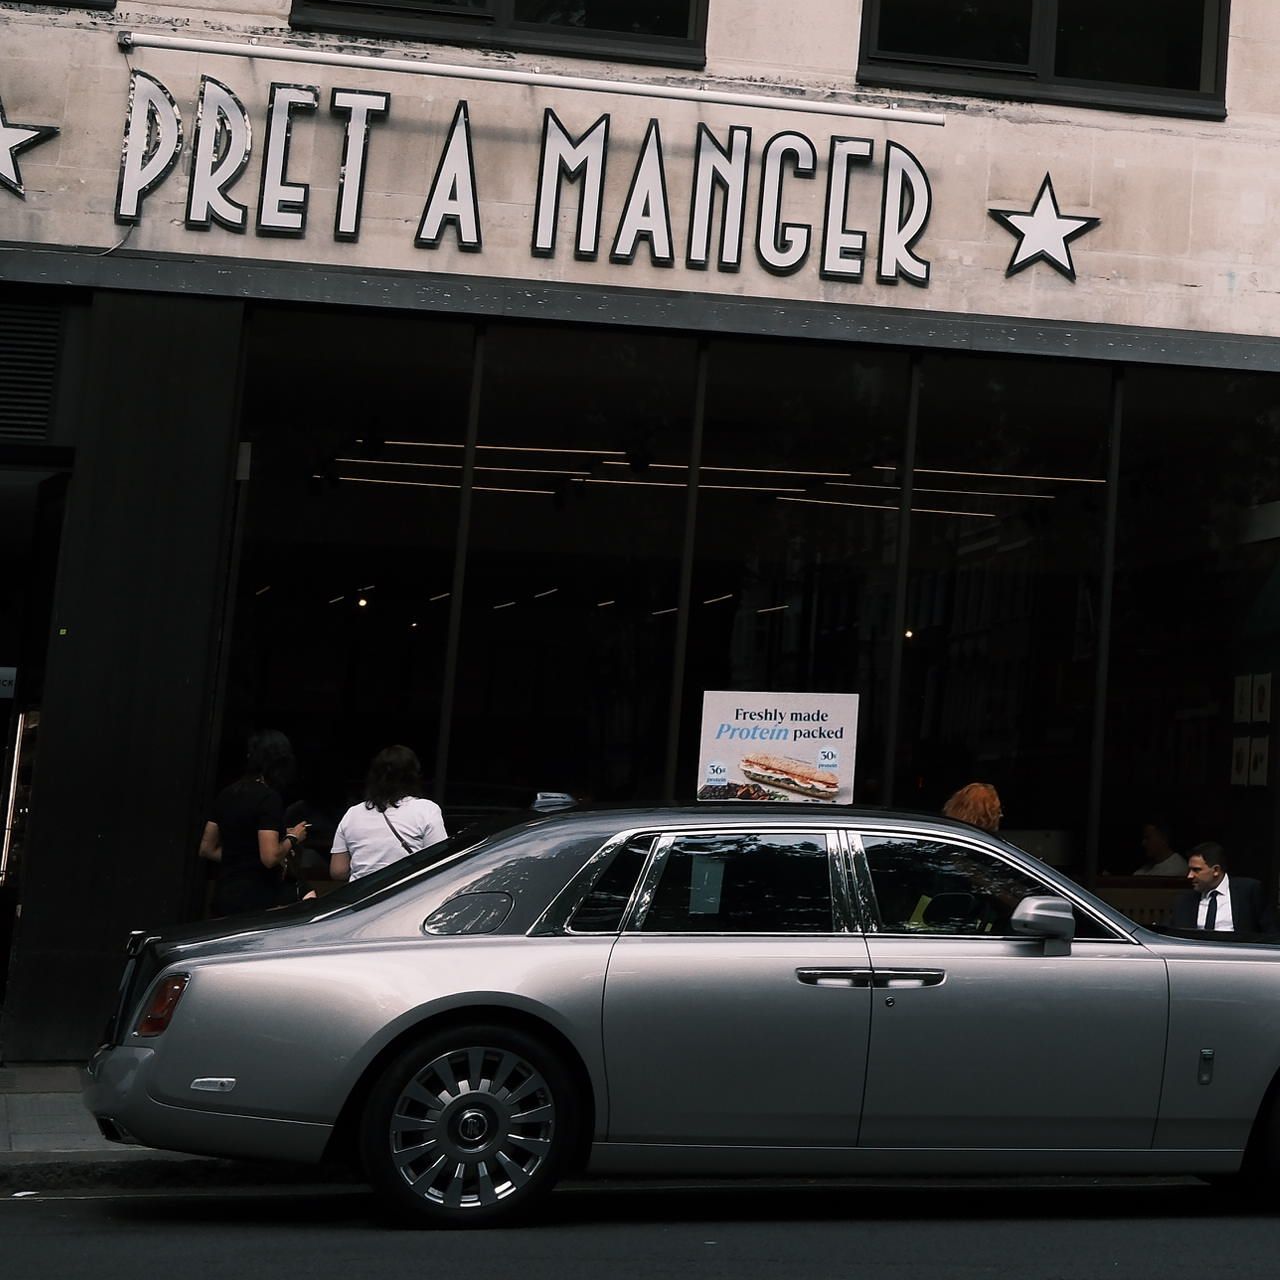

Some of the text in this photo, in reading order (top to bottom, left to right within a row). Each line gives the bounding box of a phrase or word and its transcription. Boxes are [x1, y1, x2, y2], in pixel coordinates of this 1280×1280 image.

[116, 68, 932, 288] PRET A MANGER
[735, 708, 828, 724] Freshly made
[716, 723, 844, 741] Protein packed
